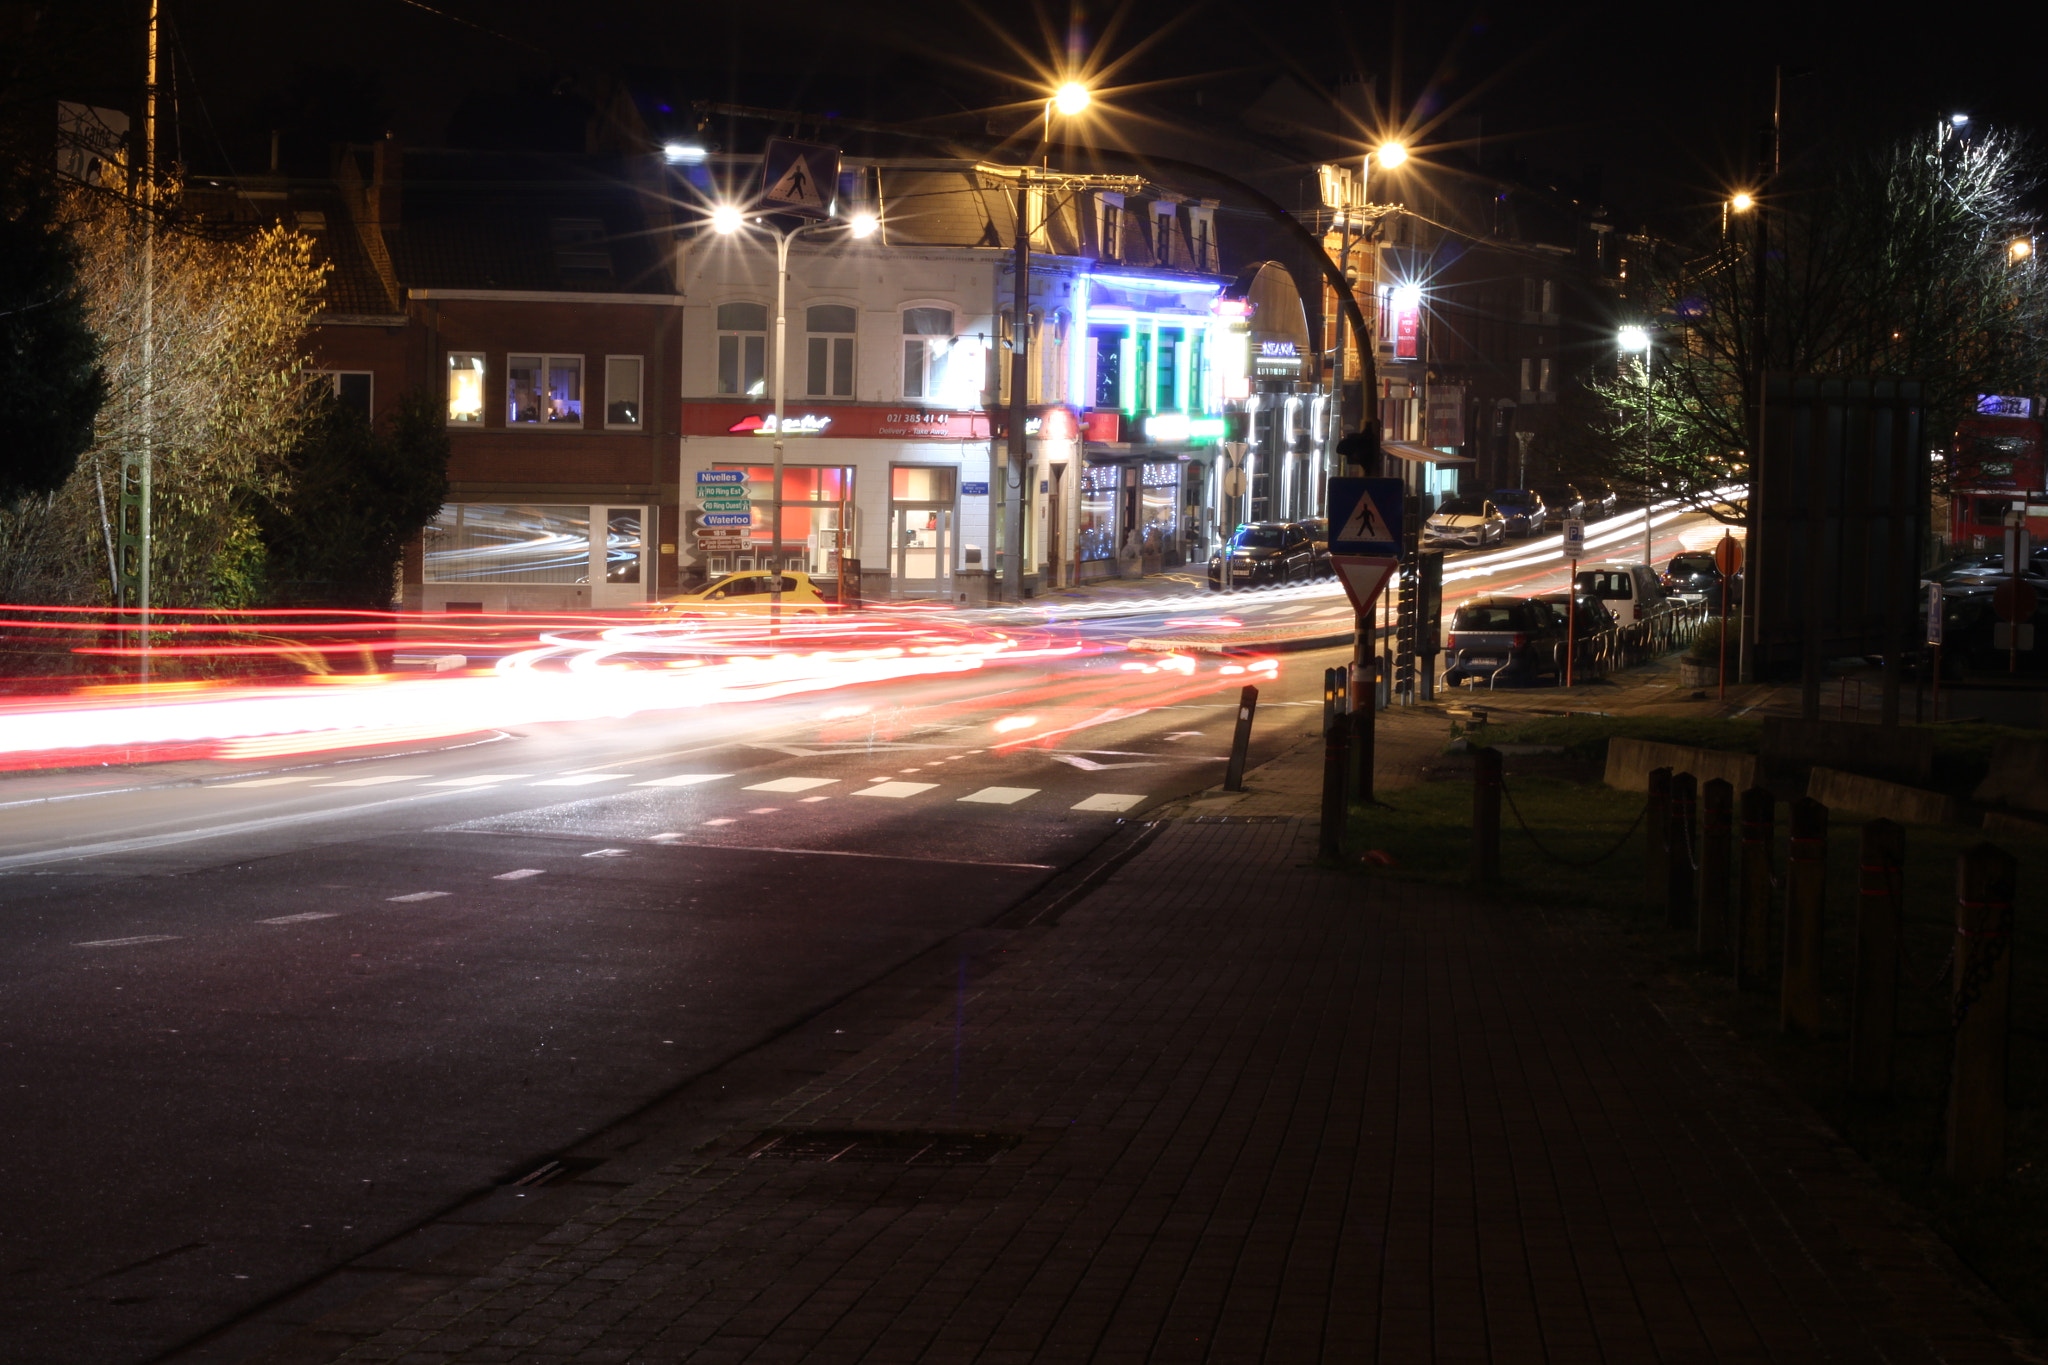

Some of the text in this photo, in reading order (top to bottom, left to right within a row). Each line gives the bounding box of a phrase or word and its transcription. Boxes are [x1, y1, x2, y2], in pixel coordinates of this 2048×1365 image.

[903, 414, 921, 423] 385
[923, 414, 935, 423] 41
[937, 414, 949, 423] 41
[878, 427, 907, 436] Delivery
[913, 427, 929, 435] Take
[929, 427, 949, 436] Away
[701, 473, 737, 482] Nivelles
[715, 488, 730, 496] Ring
[714, 503, 725, 511] Ring
[708, 516, 749, 524] Waterloo
